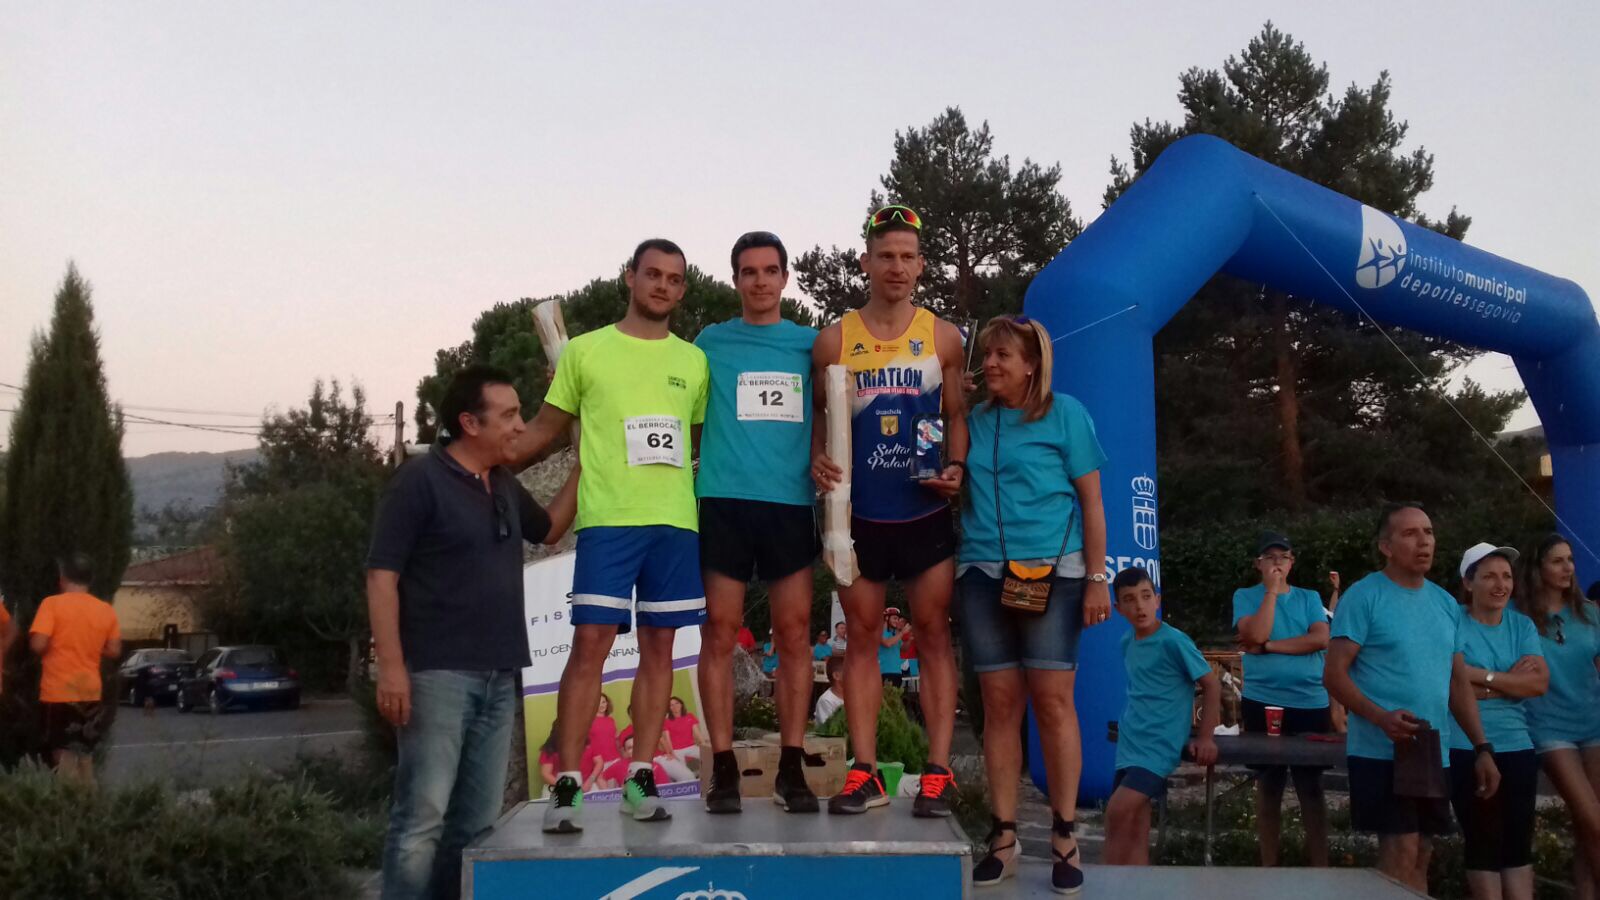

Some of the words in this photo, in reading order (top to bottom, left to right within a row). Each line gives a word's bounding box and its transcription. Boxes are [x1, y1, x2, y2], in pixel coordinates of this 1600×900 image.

[1410, 248, 1527, 305] institutomunicipal
[758, 390, 784, 406] 12
[647, 432, 674, 450] 62
[532, 648, 547, 658] TU
